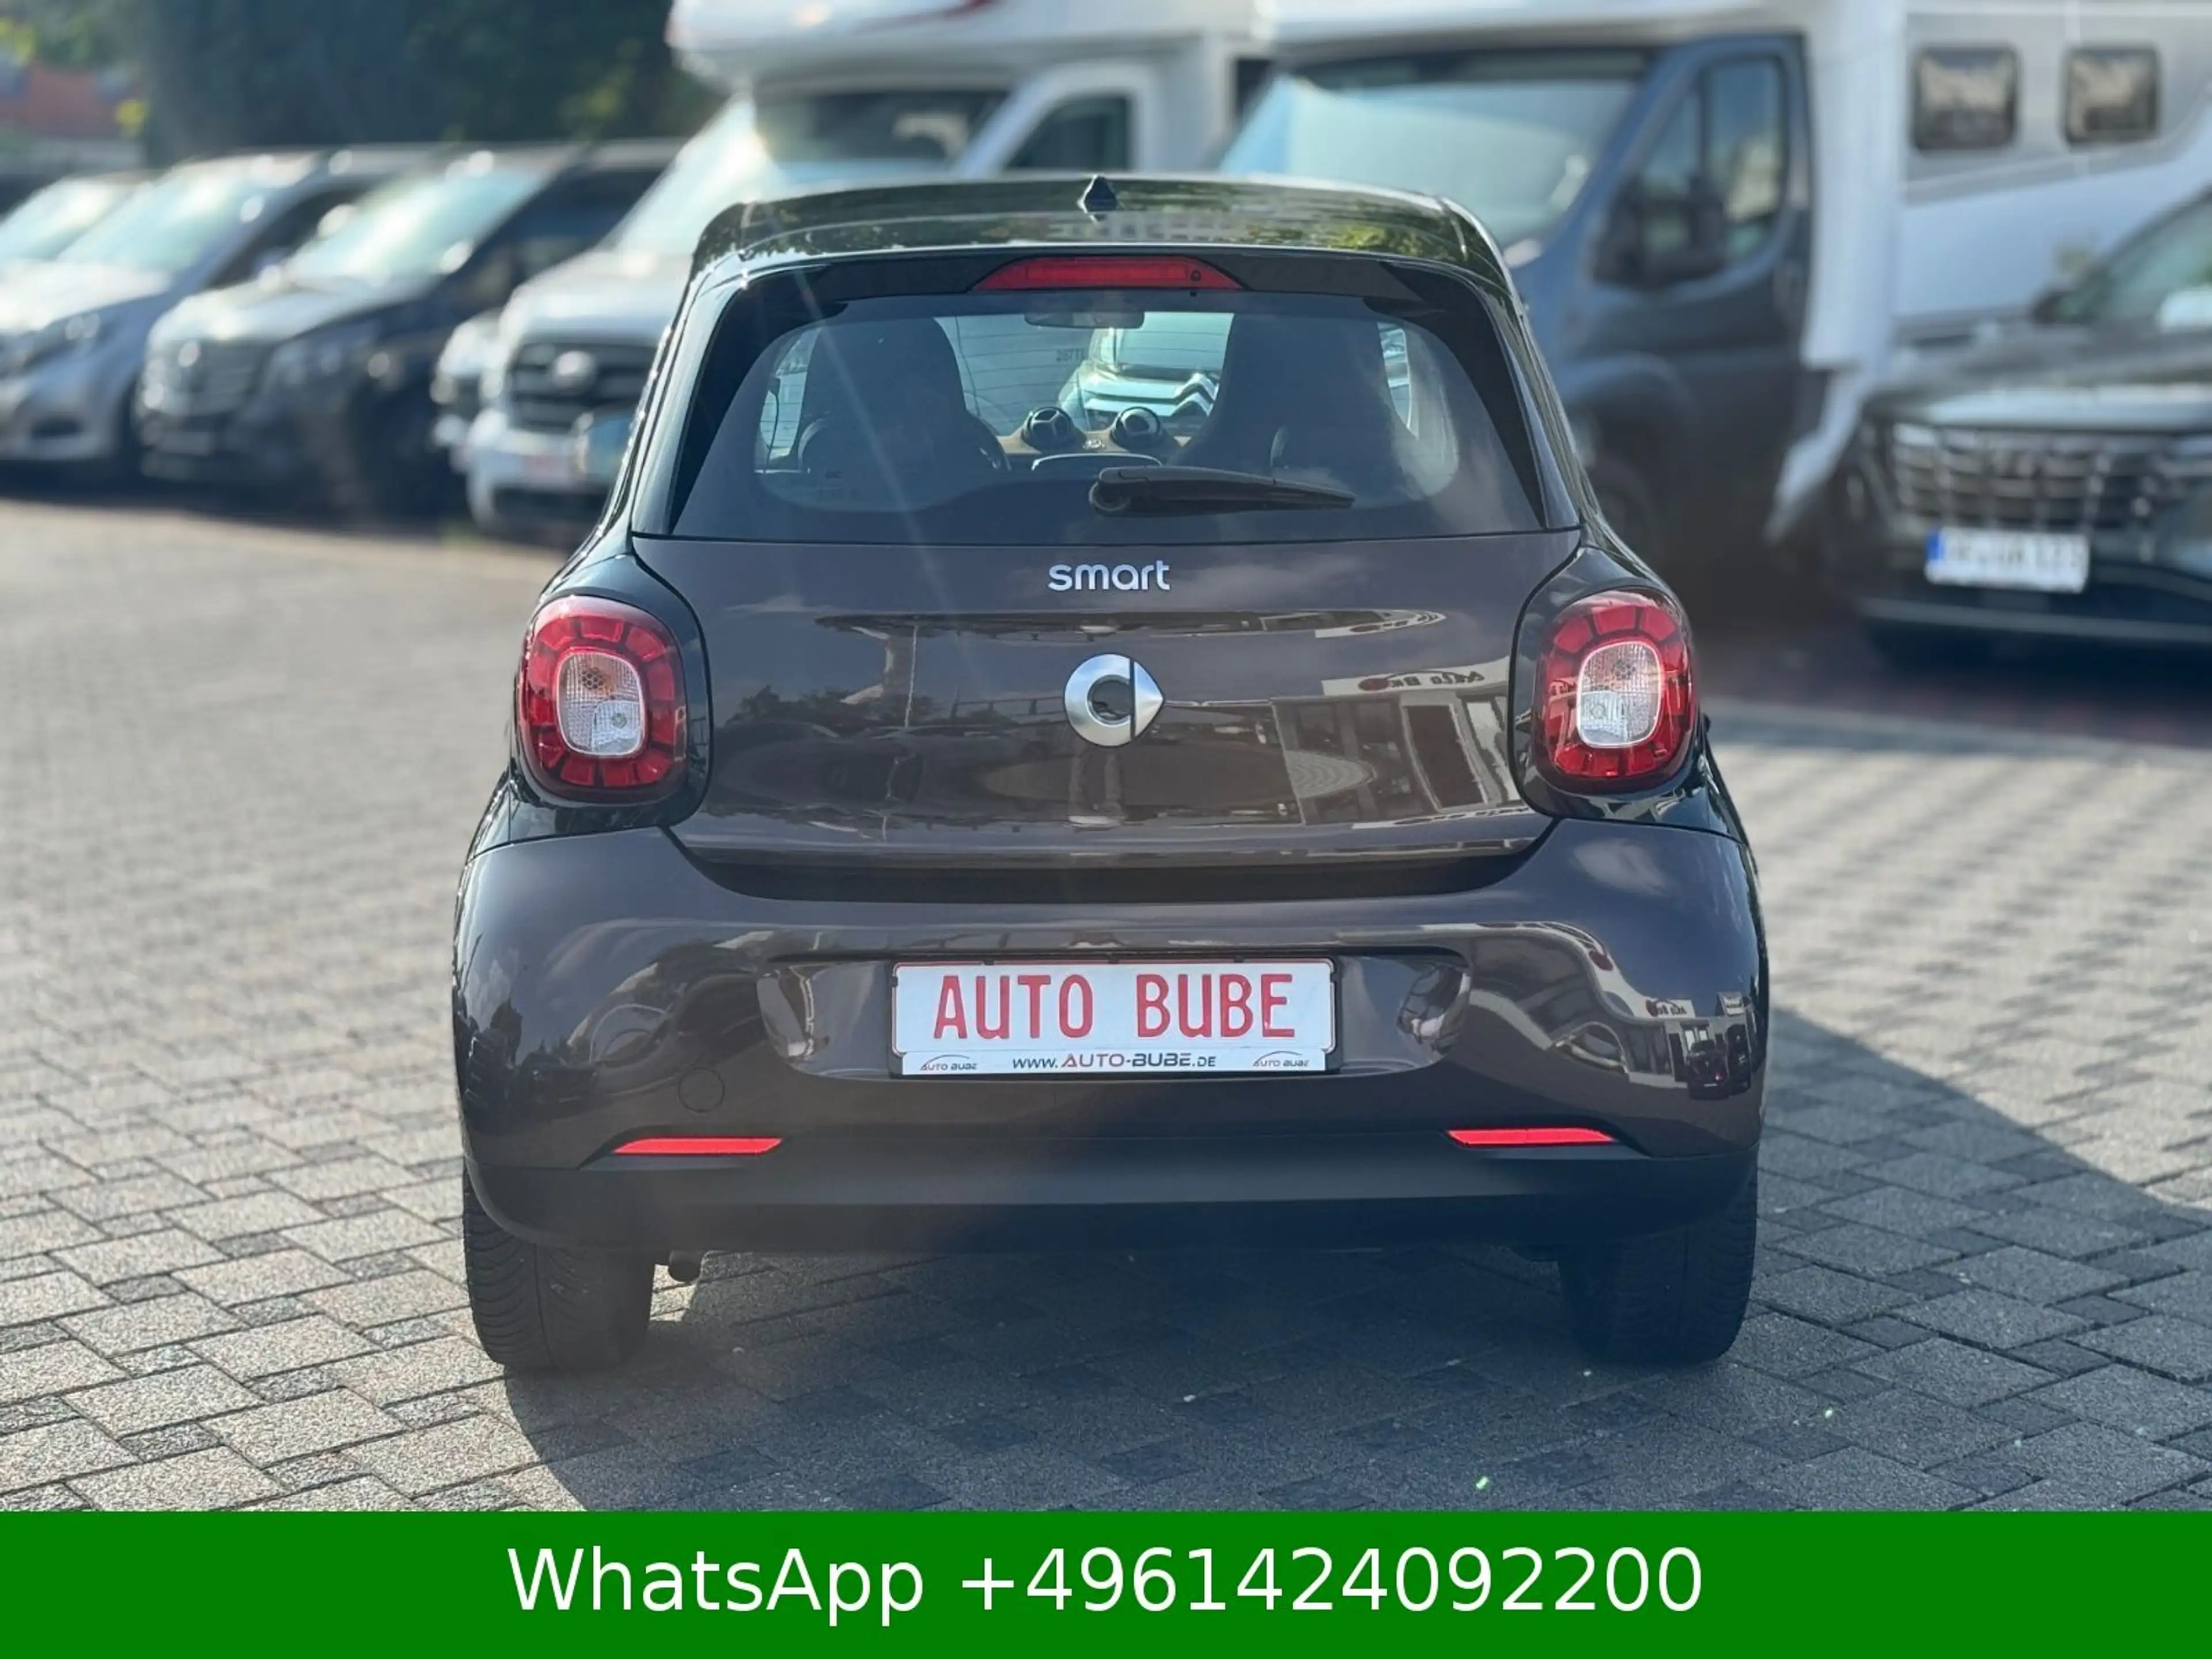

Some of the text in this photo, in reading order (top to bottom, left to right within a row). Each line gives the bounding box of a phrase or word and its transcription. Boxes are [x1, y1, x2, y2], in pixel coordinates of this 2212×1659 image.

[1048, 560, 1171, 591] smart
[934, 974, 1294, 1039] AUTO BUBE
[920, 1063, 949, 1071] AUTO
